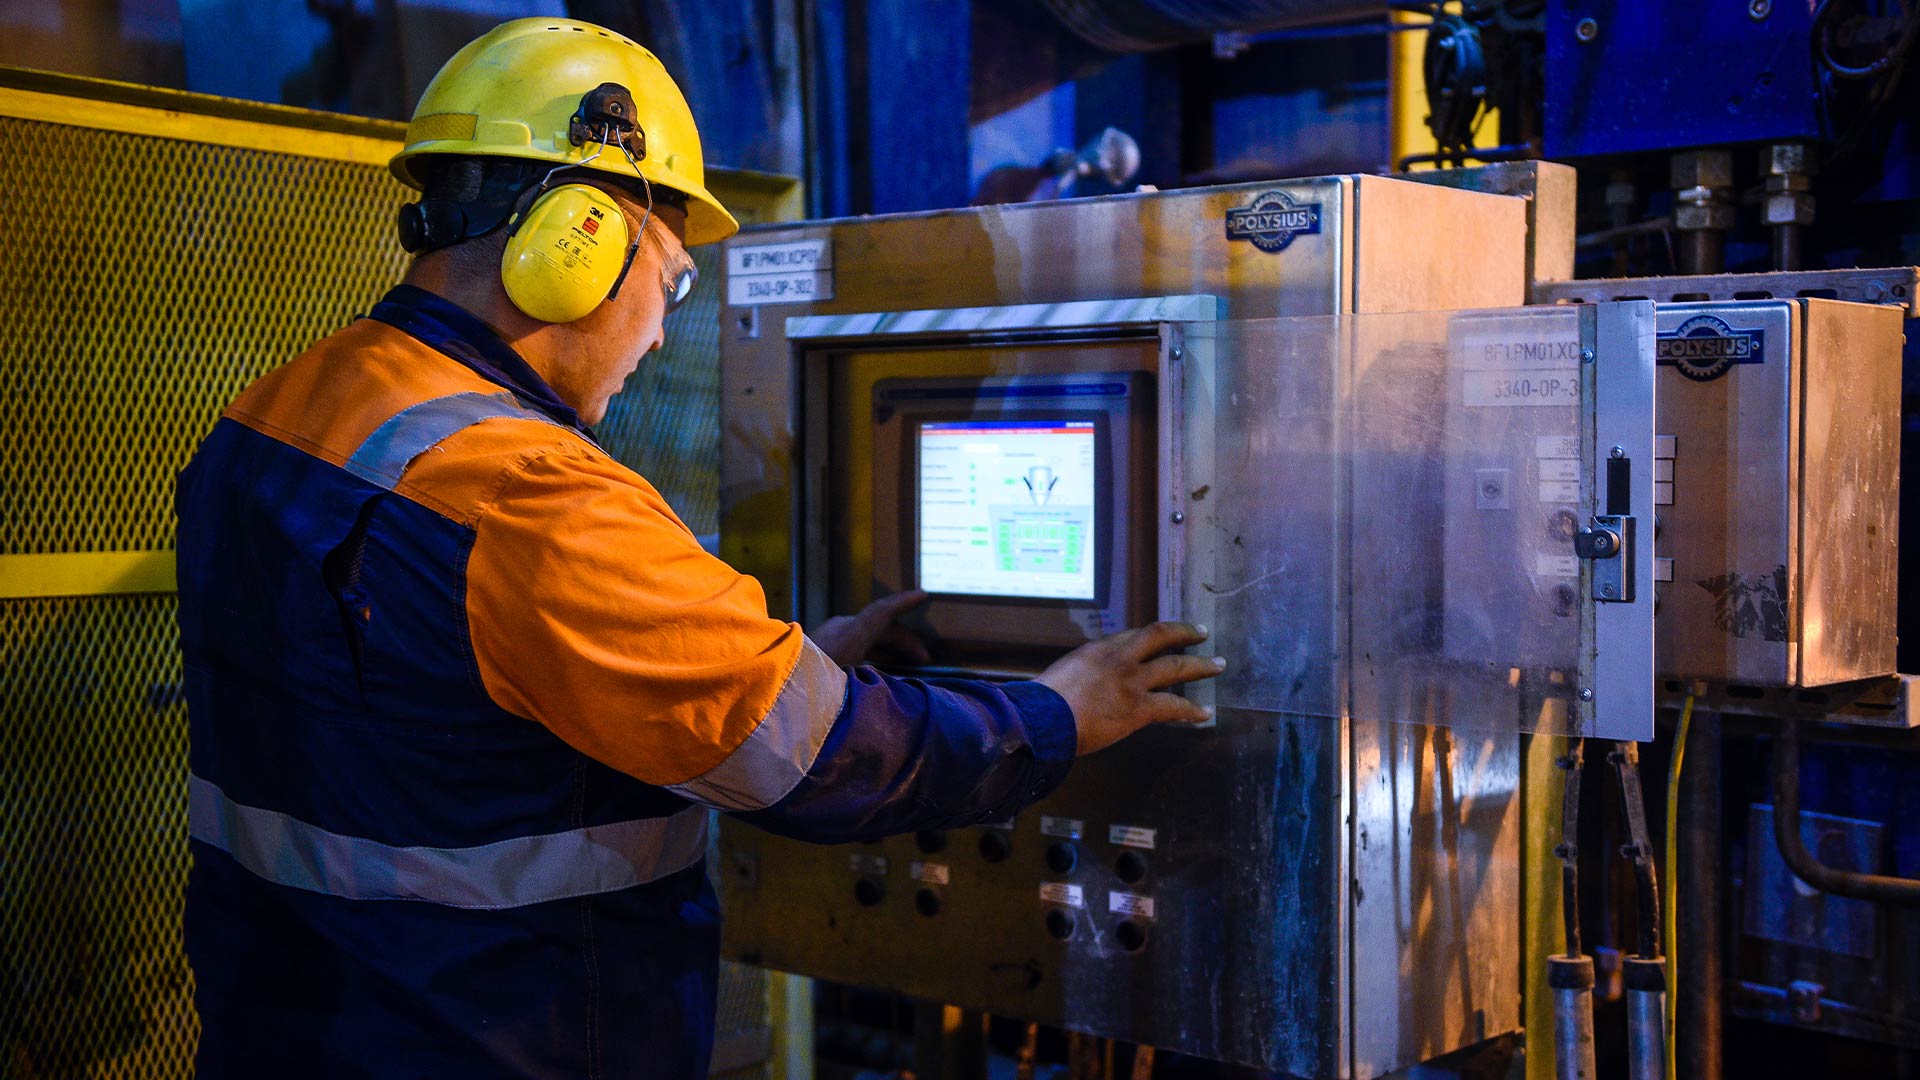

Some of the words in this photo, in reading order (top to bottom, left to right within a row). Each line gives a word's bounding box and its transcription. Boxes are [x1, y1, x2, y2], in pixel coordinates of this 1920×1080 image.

[590, 206, 604, 220] 3M
[1236, 212, 1307, 230] POLYSIUS
[1658, 338, 1748, 357] POLYSIUS
